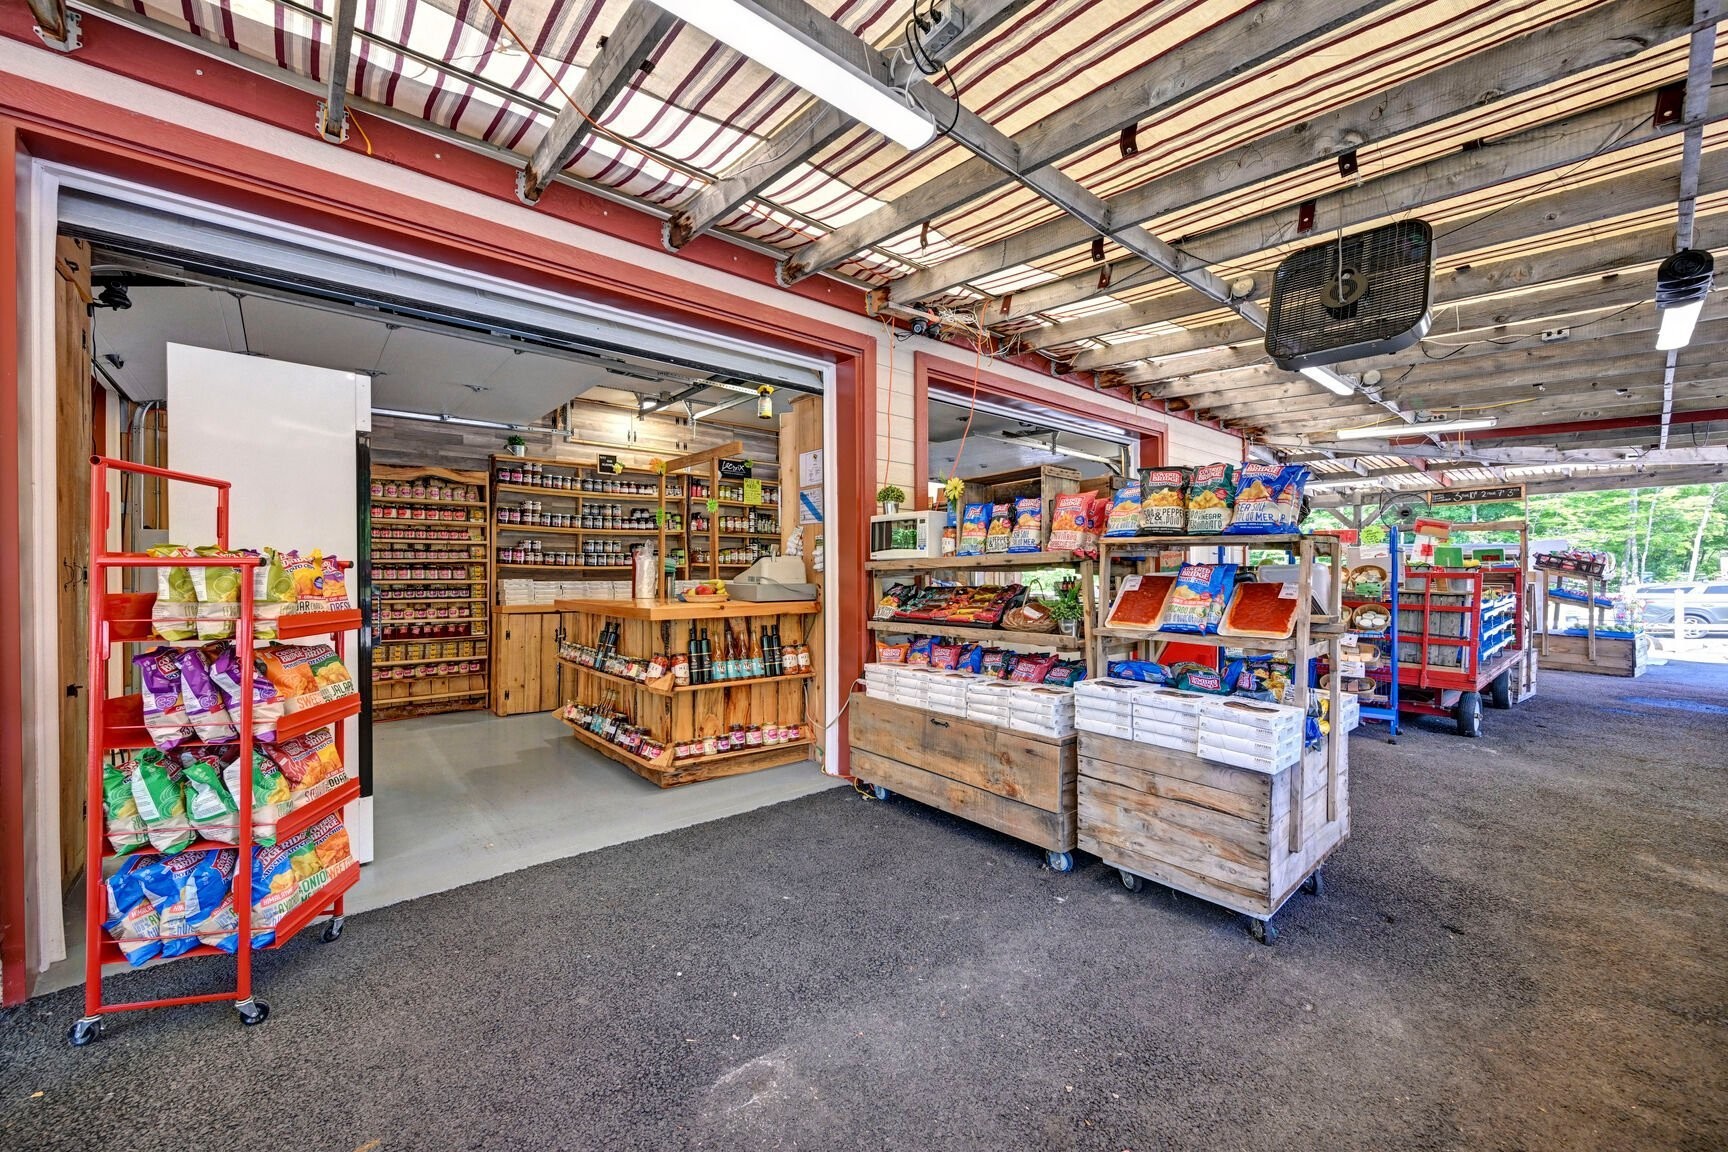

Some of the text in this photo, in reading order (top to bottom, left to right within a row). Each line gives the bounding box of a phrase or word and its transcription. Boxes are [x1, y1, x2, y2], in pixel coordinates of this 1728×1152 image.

[1255, 513, 1274, 521] MER
[1184, 566, 1211, 574] COVERED
[1181, 570, 1210, 580] BRIDGE
